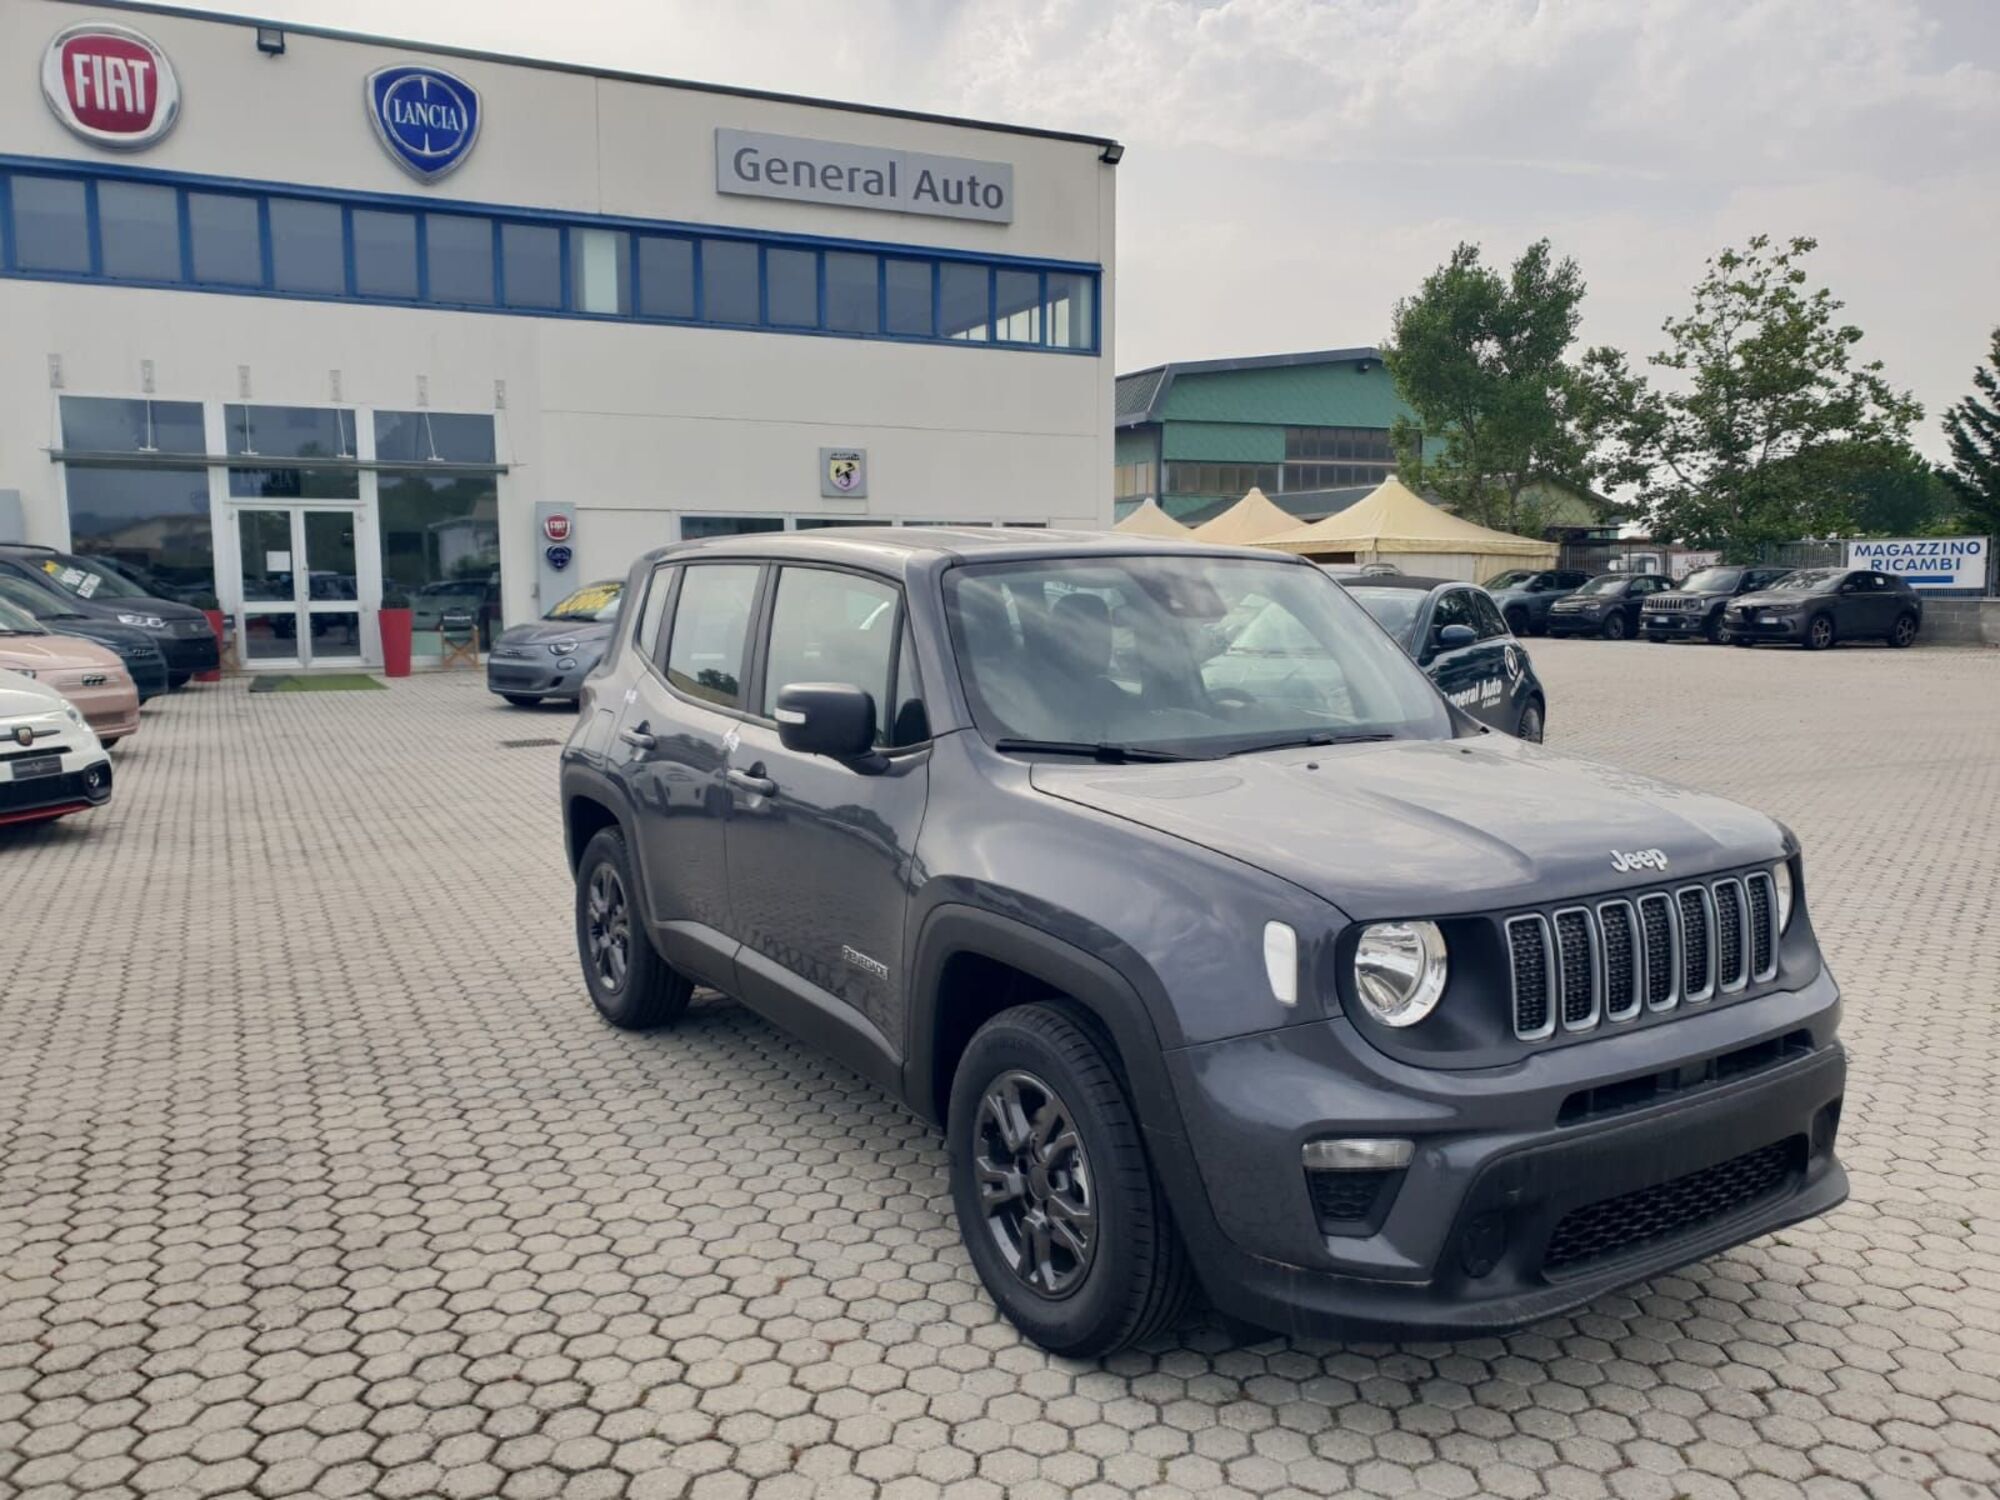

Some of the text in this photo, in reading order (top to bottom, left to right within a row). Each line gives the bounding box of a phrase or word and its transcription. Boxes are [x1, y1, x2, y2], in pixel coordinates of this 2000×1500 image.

[72, 53, 150, 114] FIAT
[392, 98, 460, 131] LANCIA
[733, 147, 1004, 209] General Auto
[1854, 541, 1981, 557] MAGAZZINO
[1870, 558, 1961, 571] RICAMBI
[1481, 677, 1502, 700] Auto
[1609, 848, 1668, 873] Jeep
